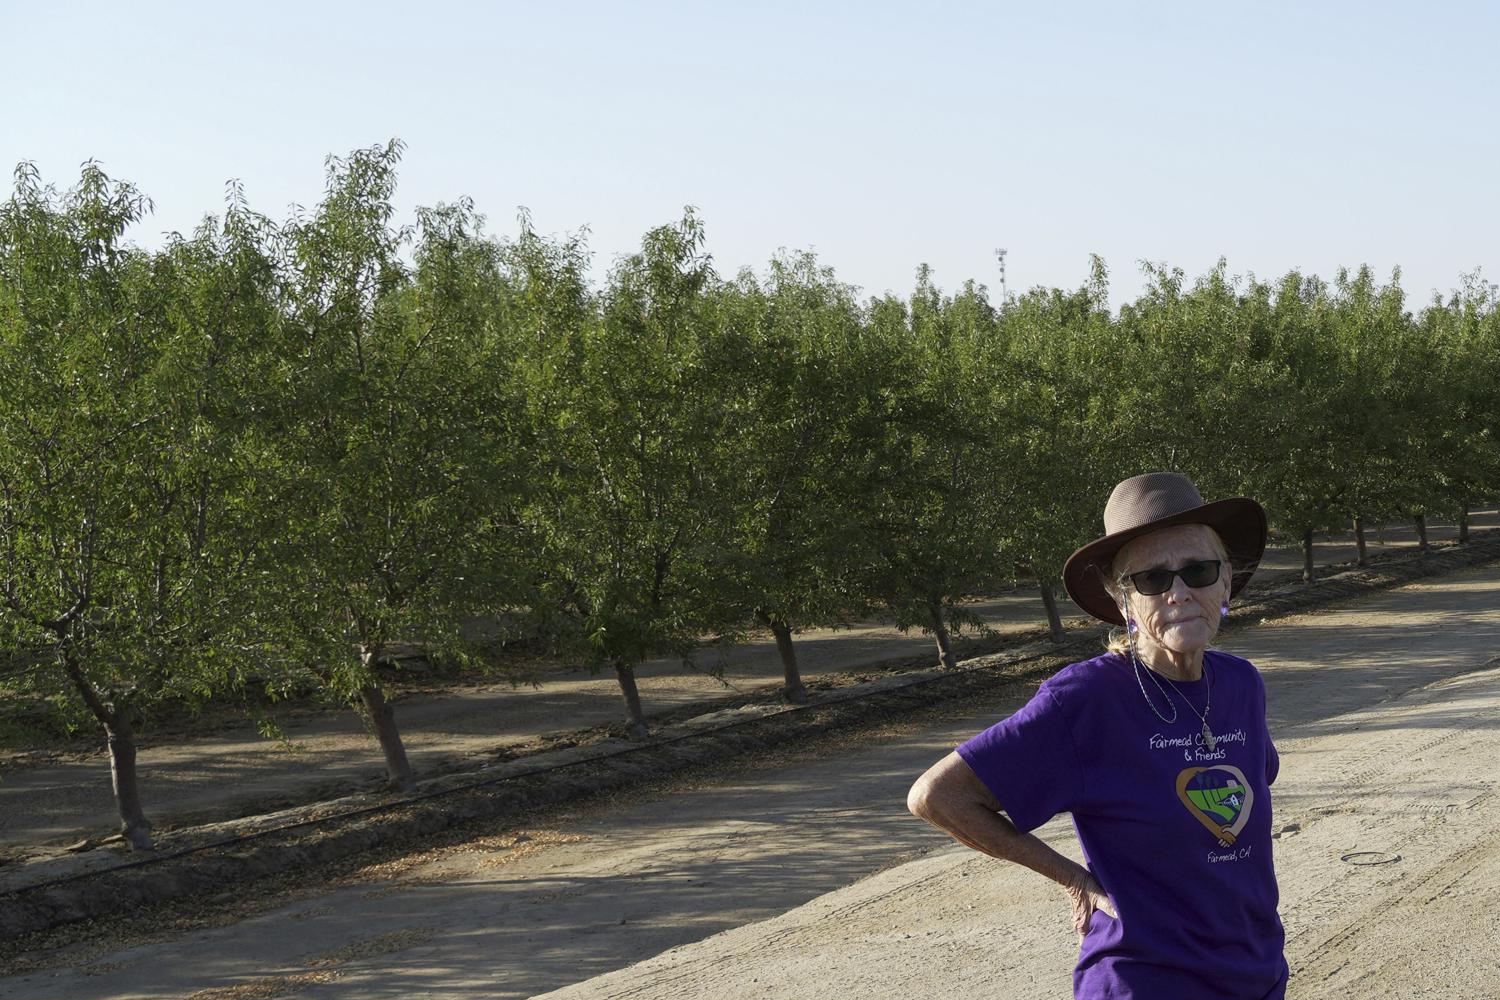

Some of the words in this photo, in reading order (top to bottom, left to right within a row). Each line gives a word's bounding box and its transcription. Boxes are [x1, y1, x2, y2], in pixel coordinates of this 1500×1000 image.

[1149, 733, 1193, 750] Fairmead
[1194, 728, 1246, 747] Cmunity
[1184, 749, 1193, 761] &
[1195, 746, 1226, 761] Friends
[1240, 845, 1252, 859] CA
